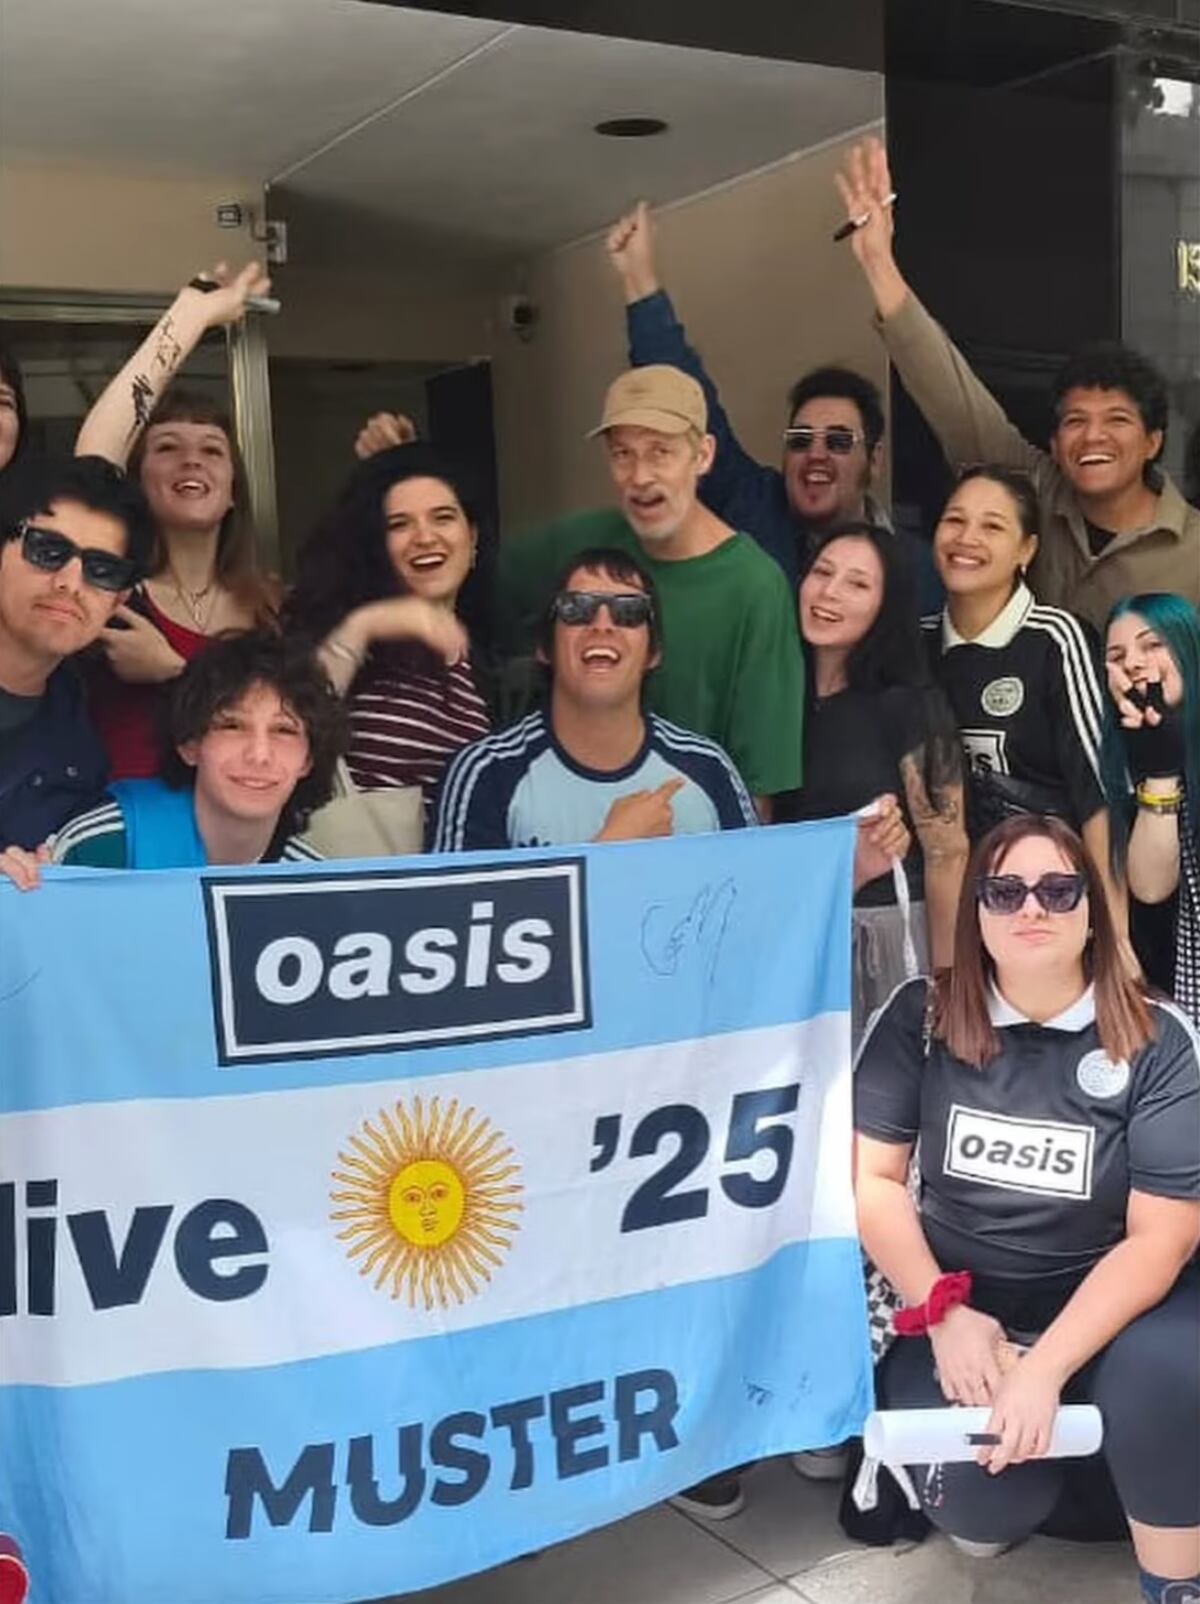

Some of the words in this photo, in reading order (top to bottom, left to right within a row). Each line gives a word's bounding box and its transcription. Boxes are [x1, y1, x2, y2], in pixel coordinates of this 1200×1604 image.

[255, 901, 553, 1005] oasis
[960, 1134, 1077, 1175] oasis
[0, 1179, 269, 1316] live
[225, 1368, 680, 1540] MUSTER
